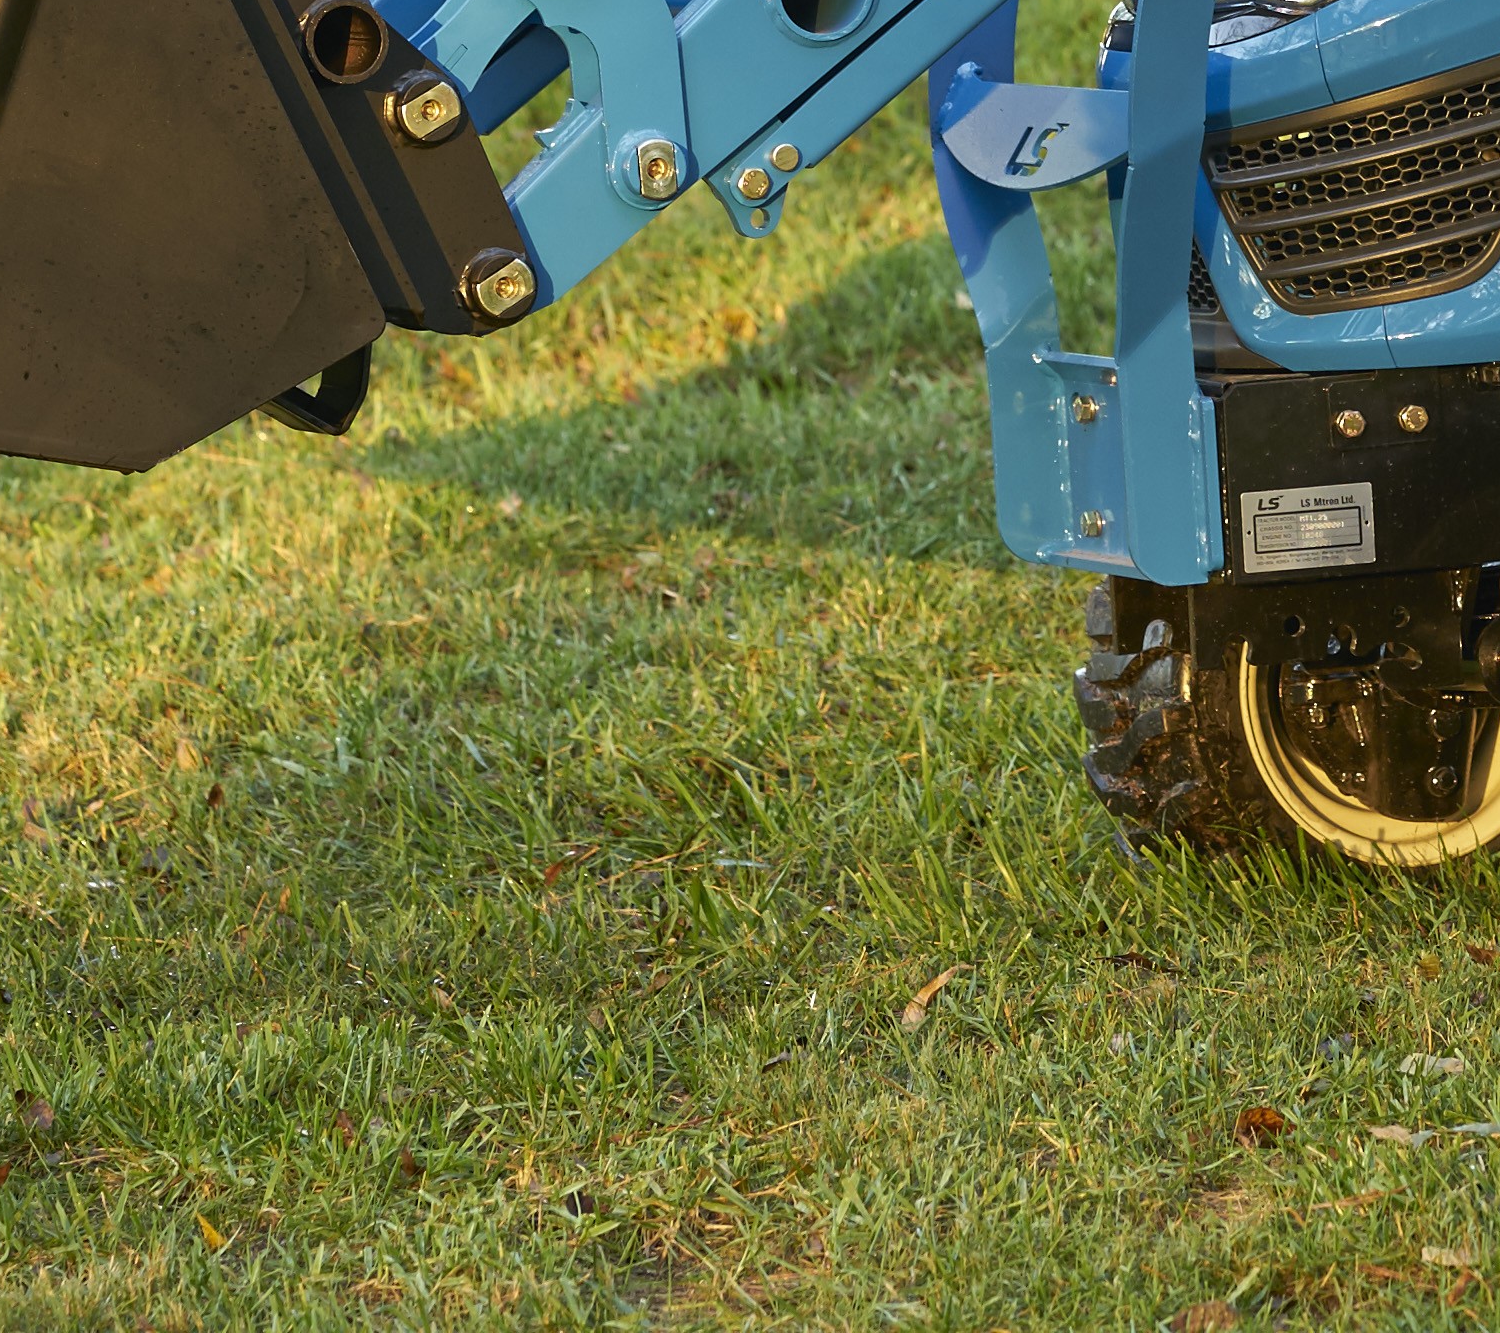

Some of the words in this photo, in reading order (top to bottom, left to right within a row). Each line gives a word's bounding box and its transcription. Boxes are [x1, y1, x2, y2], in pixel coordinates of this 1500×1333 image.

[1258, 497, 1280, 511] LS
[1301, 498, 1310, 508] LS
[1341, 495, 1356, 504] Ltd.
